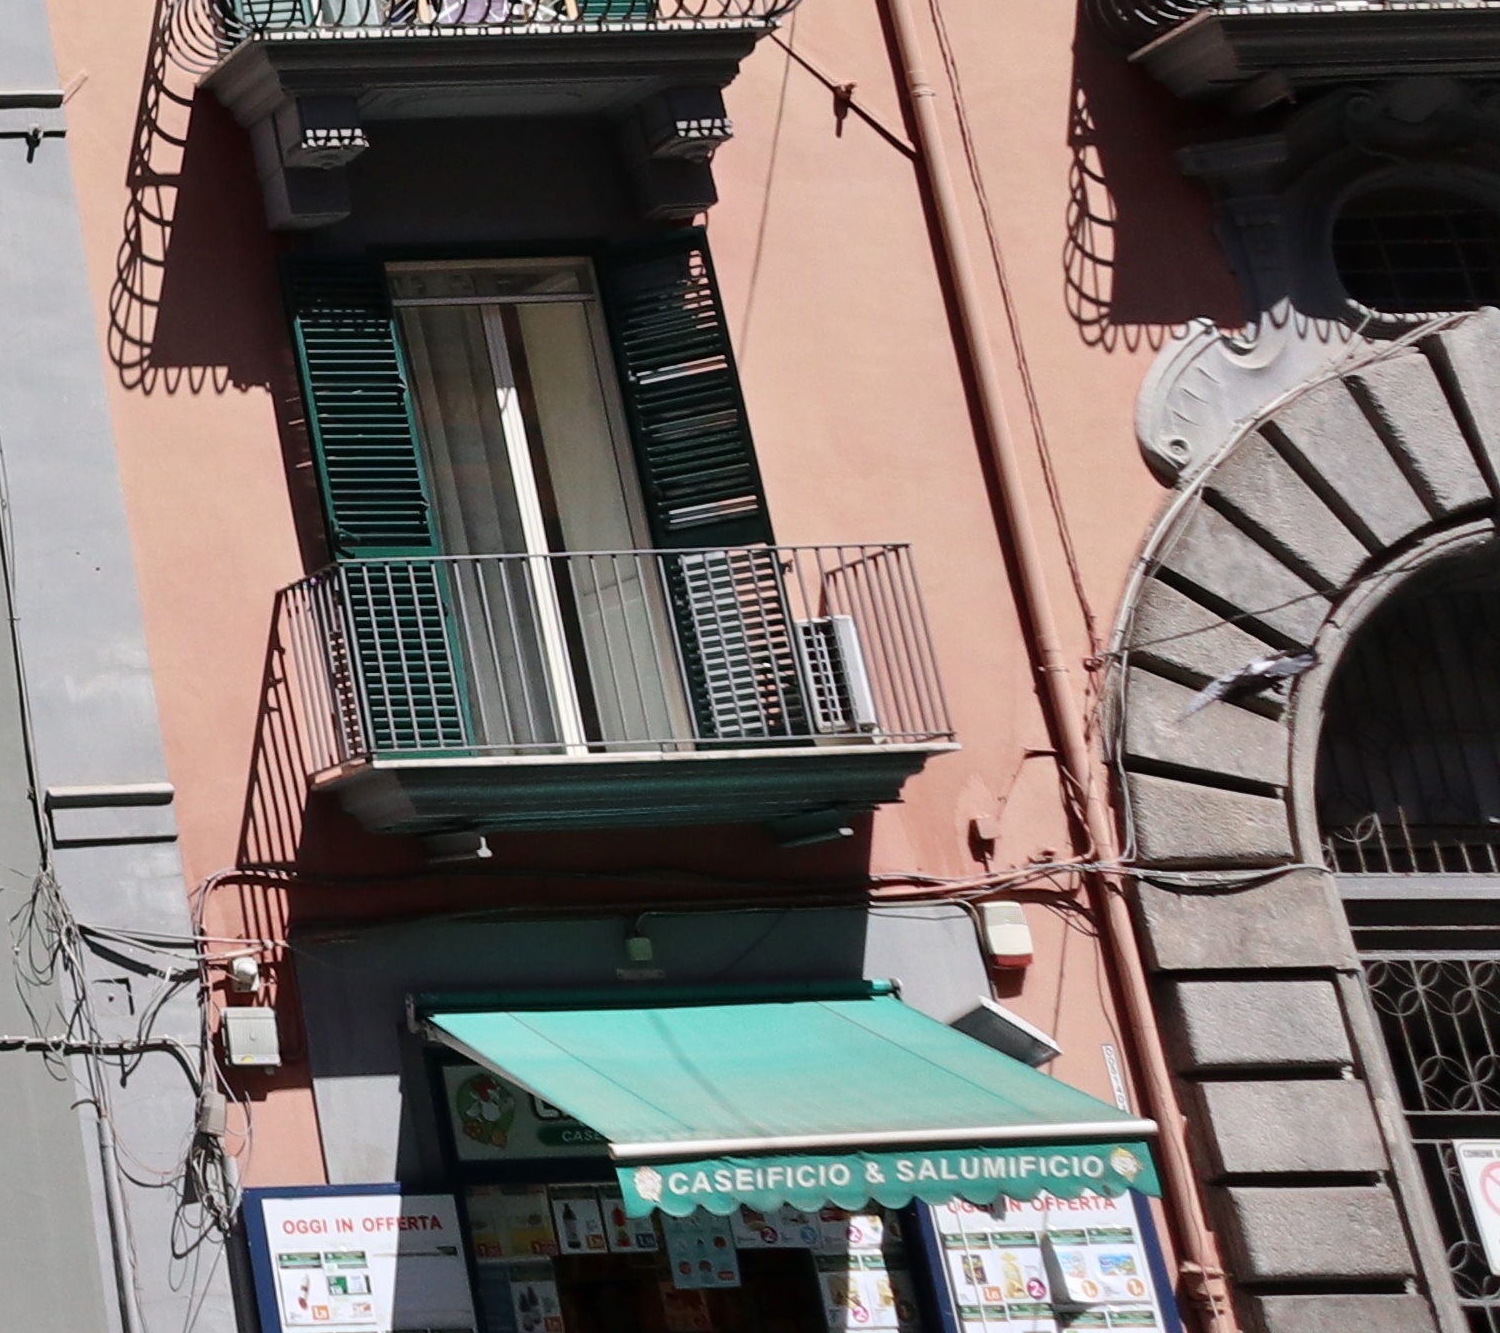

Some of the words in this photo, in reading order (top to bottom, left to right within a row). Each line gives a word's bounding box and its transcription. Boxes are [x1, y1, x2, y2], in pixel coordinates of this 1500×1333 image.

[668, 1163, 851, 1197] CASEIFICIO
[864, 1164, 886, 1185] &
[895, 1154, 1105, 1183] SALUMIFICIO
[1030, 1194, 1117, 1212] OFFERTA
[282, 1219, 328, 1235] OGGI
[336, 1218, 354, 1233] IN
[362, 1215, 443, 1233] OFFERTA
